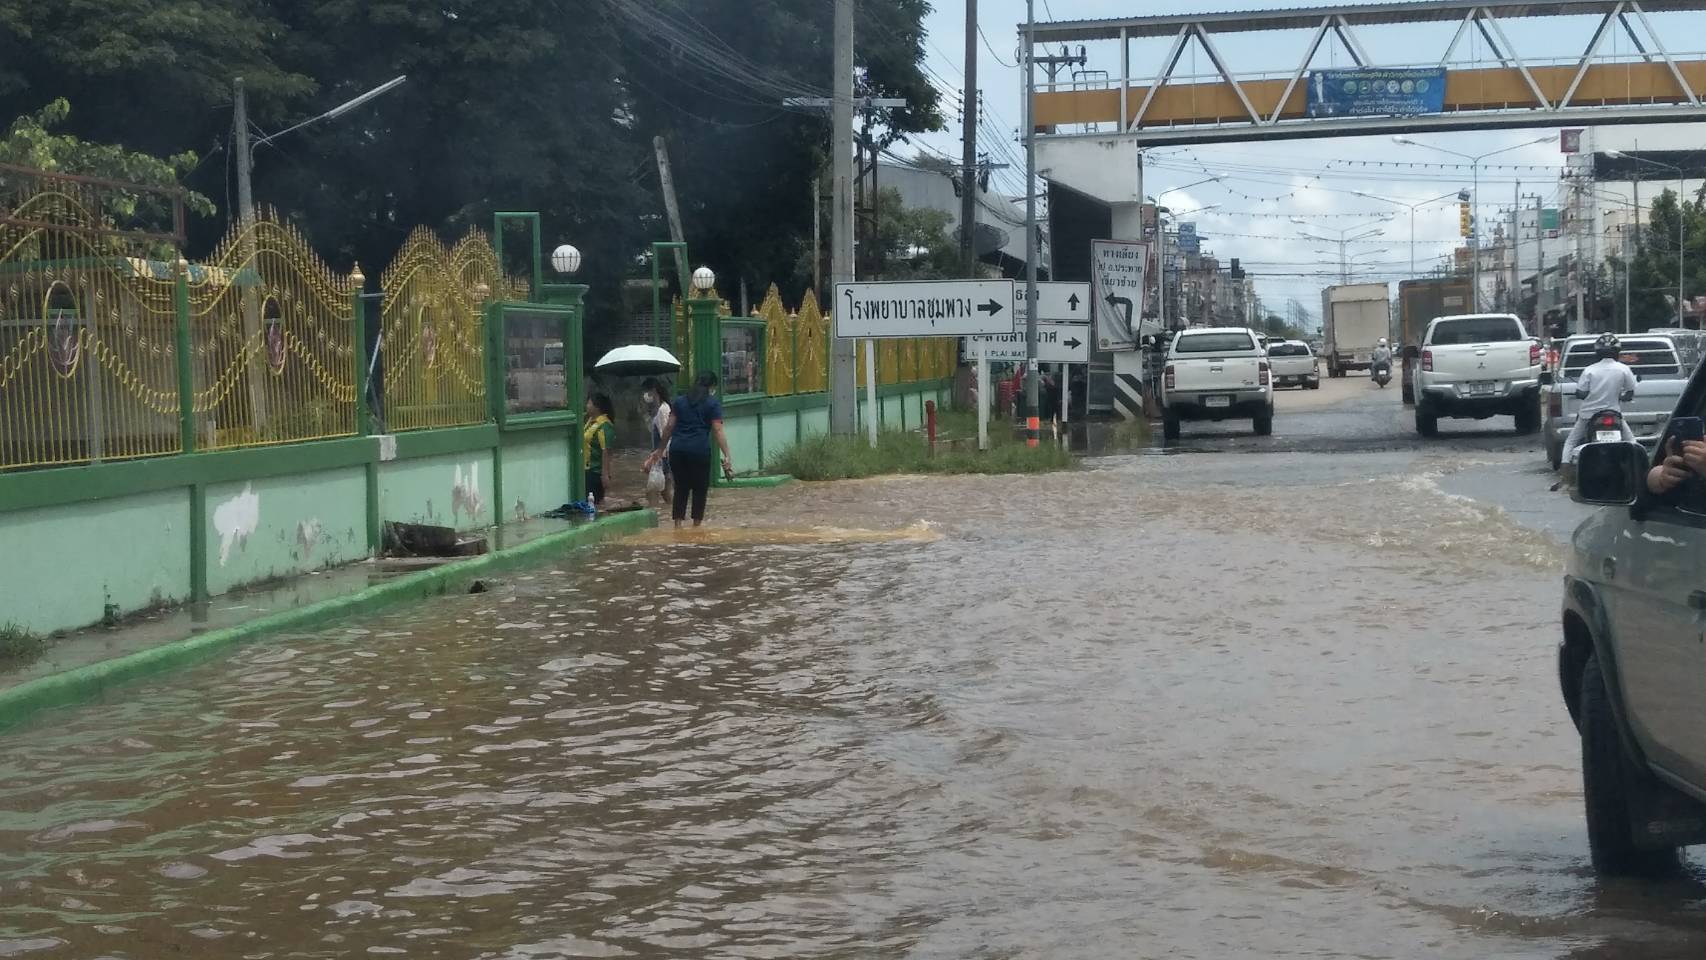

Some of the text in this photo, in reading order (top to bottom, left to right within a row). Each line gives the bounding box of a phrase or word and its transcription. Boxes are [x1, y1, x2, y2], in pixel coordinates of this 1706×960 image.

[844, 289, 972, 327] โรงพยาบาลชุมพวง
